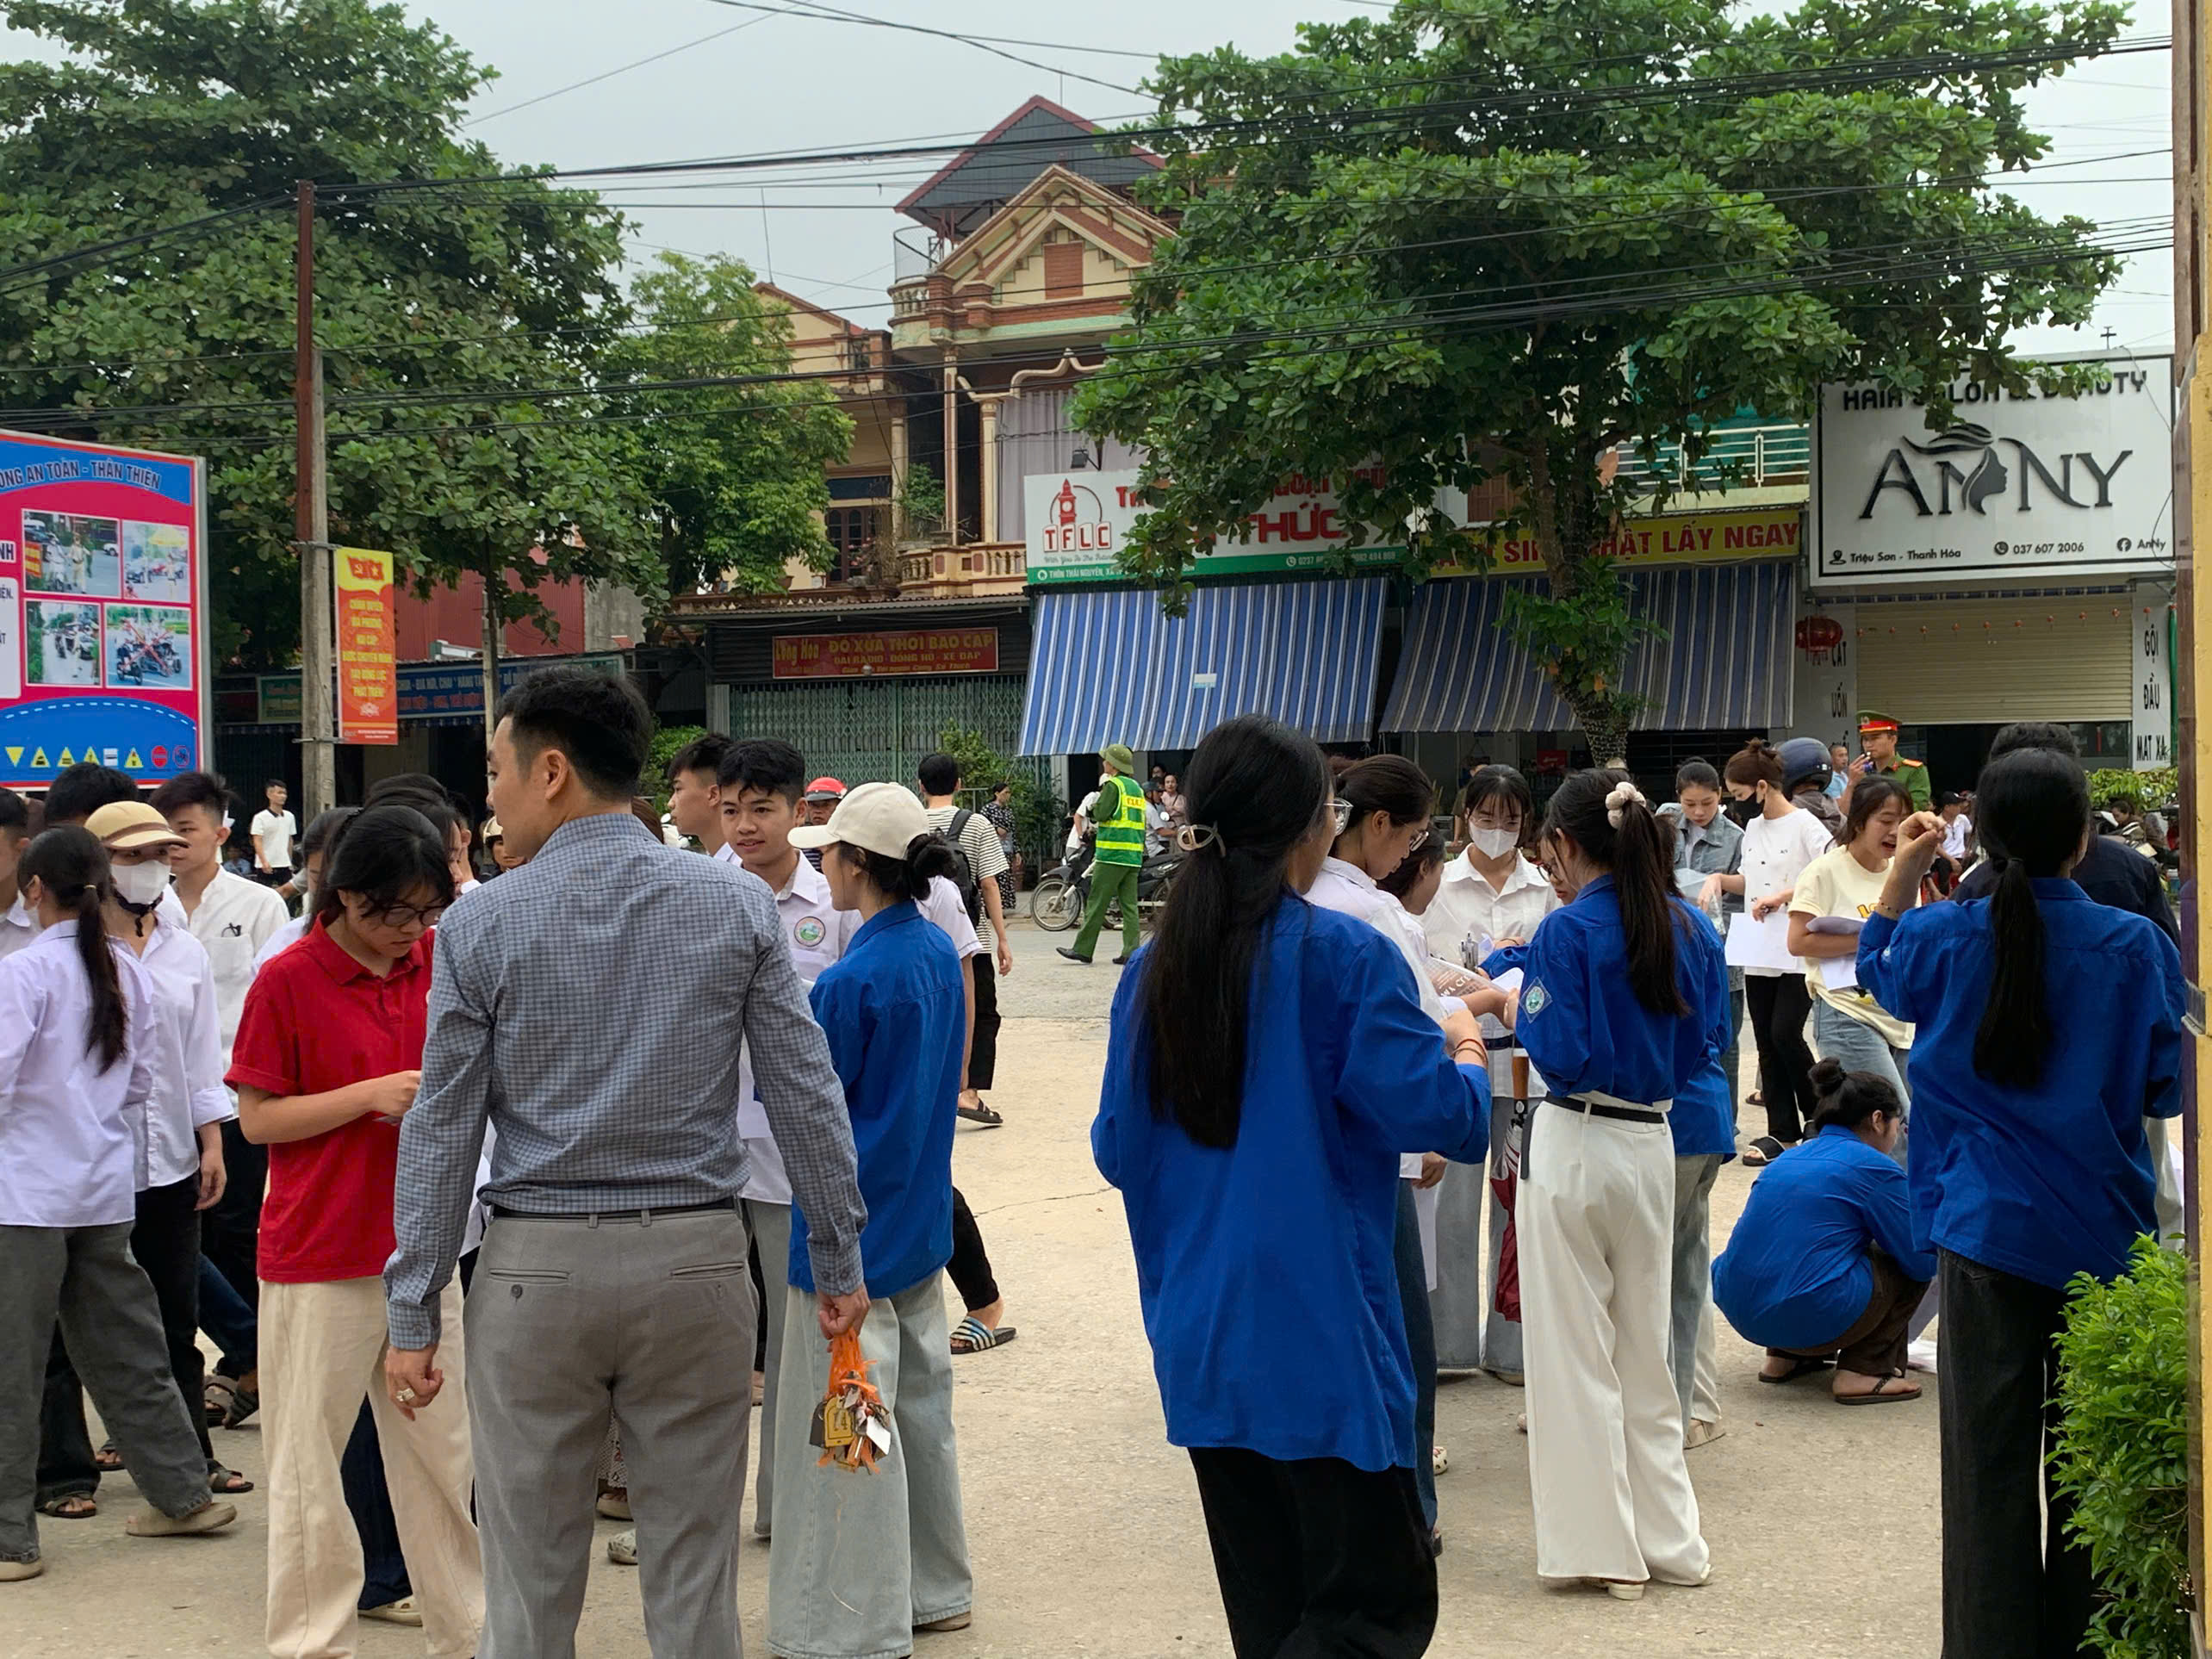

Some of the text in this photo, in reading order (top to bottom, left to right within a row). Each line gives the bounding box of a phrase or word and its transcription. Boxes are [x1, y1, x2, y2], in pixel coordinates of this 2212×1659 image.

[27, 465, 44, 483] AN
[1045, 525, 1109, 550] TFLC
[1662, 519, 1714, 553] LẤY
[1724, 523, 1799, 549] NGAY
[1907, 549, 1937, 560] Thanh
[2035, 544, 2054, 554] 607
[2058, 542, 2085, 552] 2006
